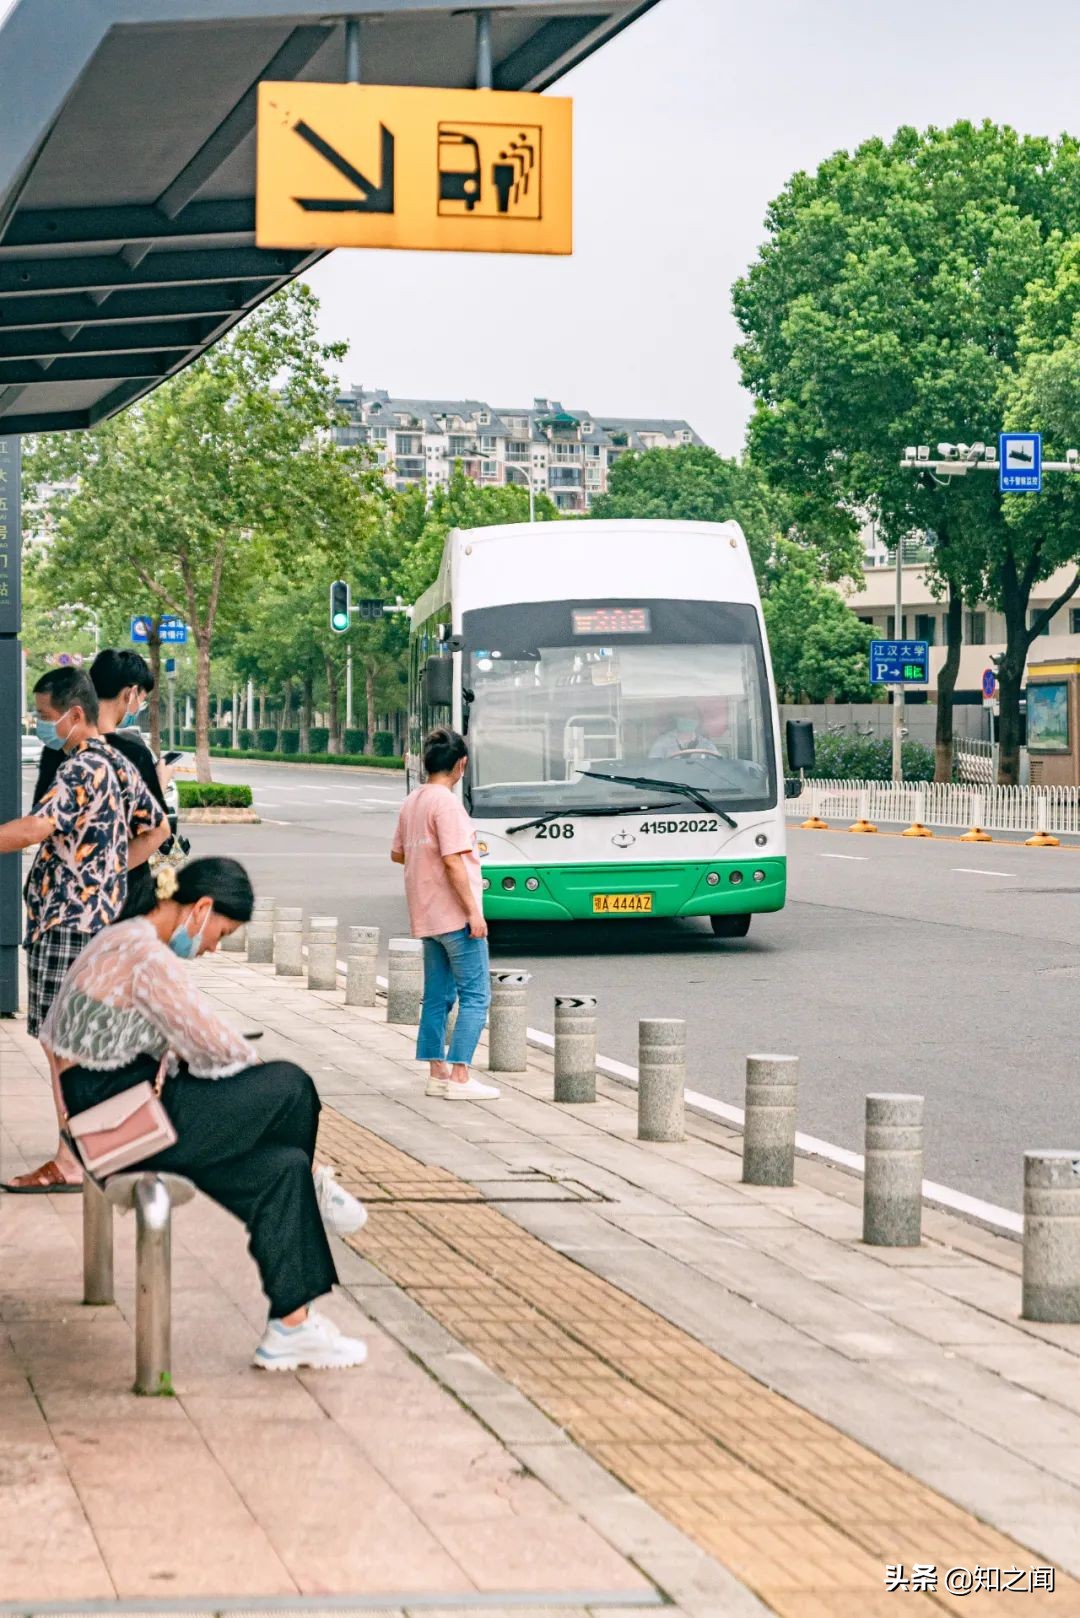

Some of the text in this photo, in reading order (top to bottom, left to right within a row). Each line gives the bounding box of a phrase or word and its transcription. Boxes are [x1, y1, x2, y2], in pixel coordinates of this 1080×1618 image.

[874, 645, 925, 656] 江汉大学
[876, 663, 888, 680] P
[535, 823, 575, 839] 208
[639, 819, 718, 834] 415D2022
